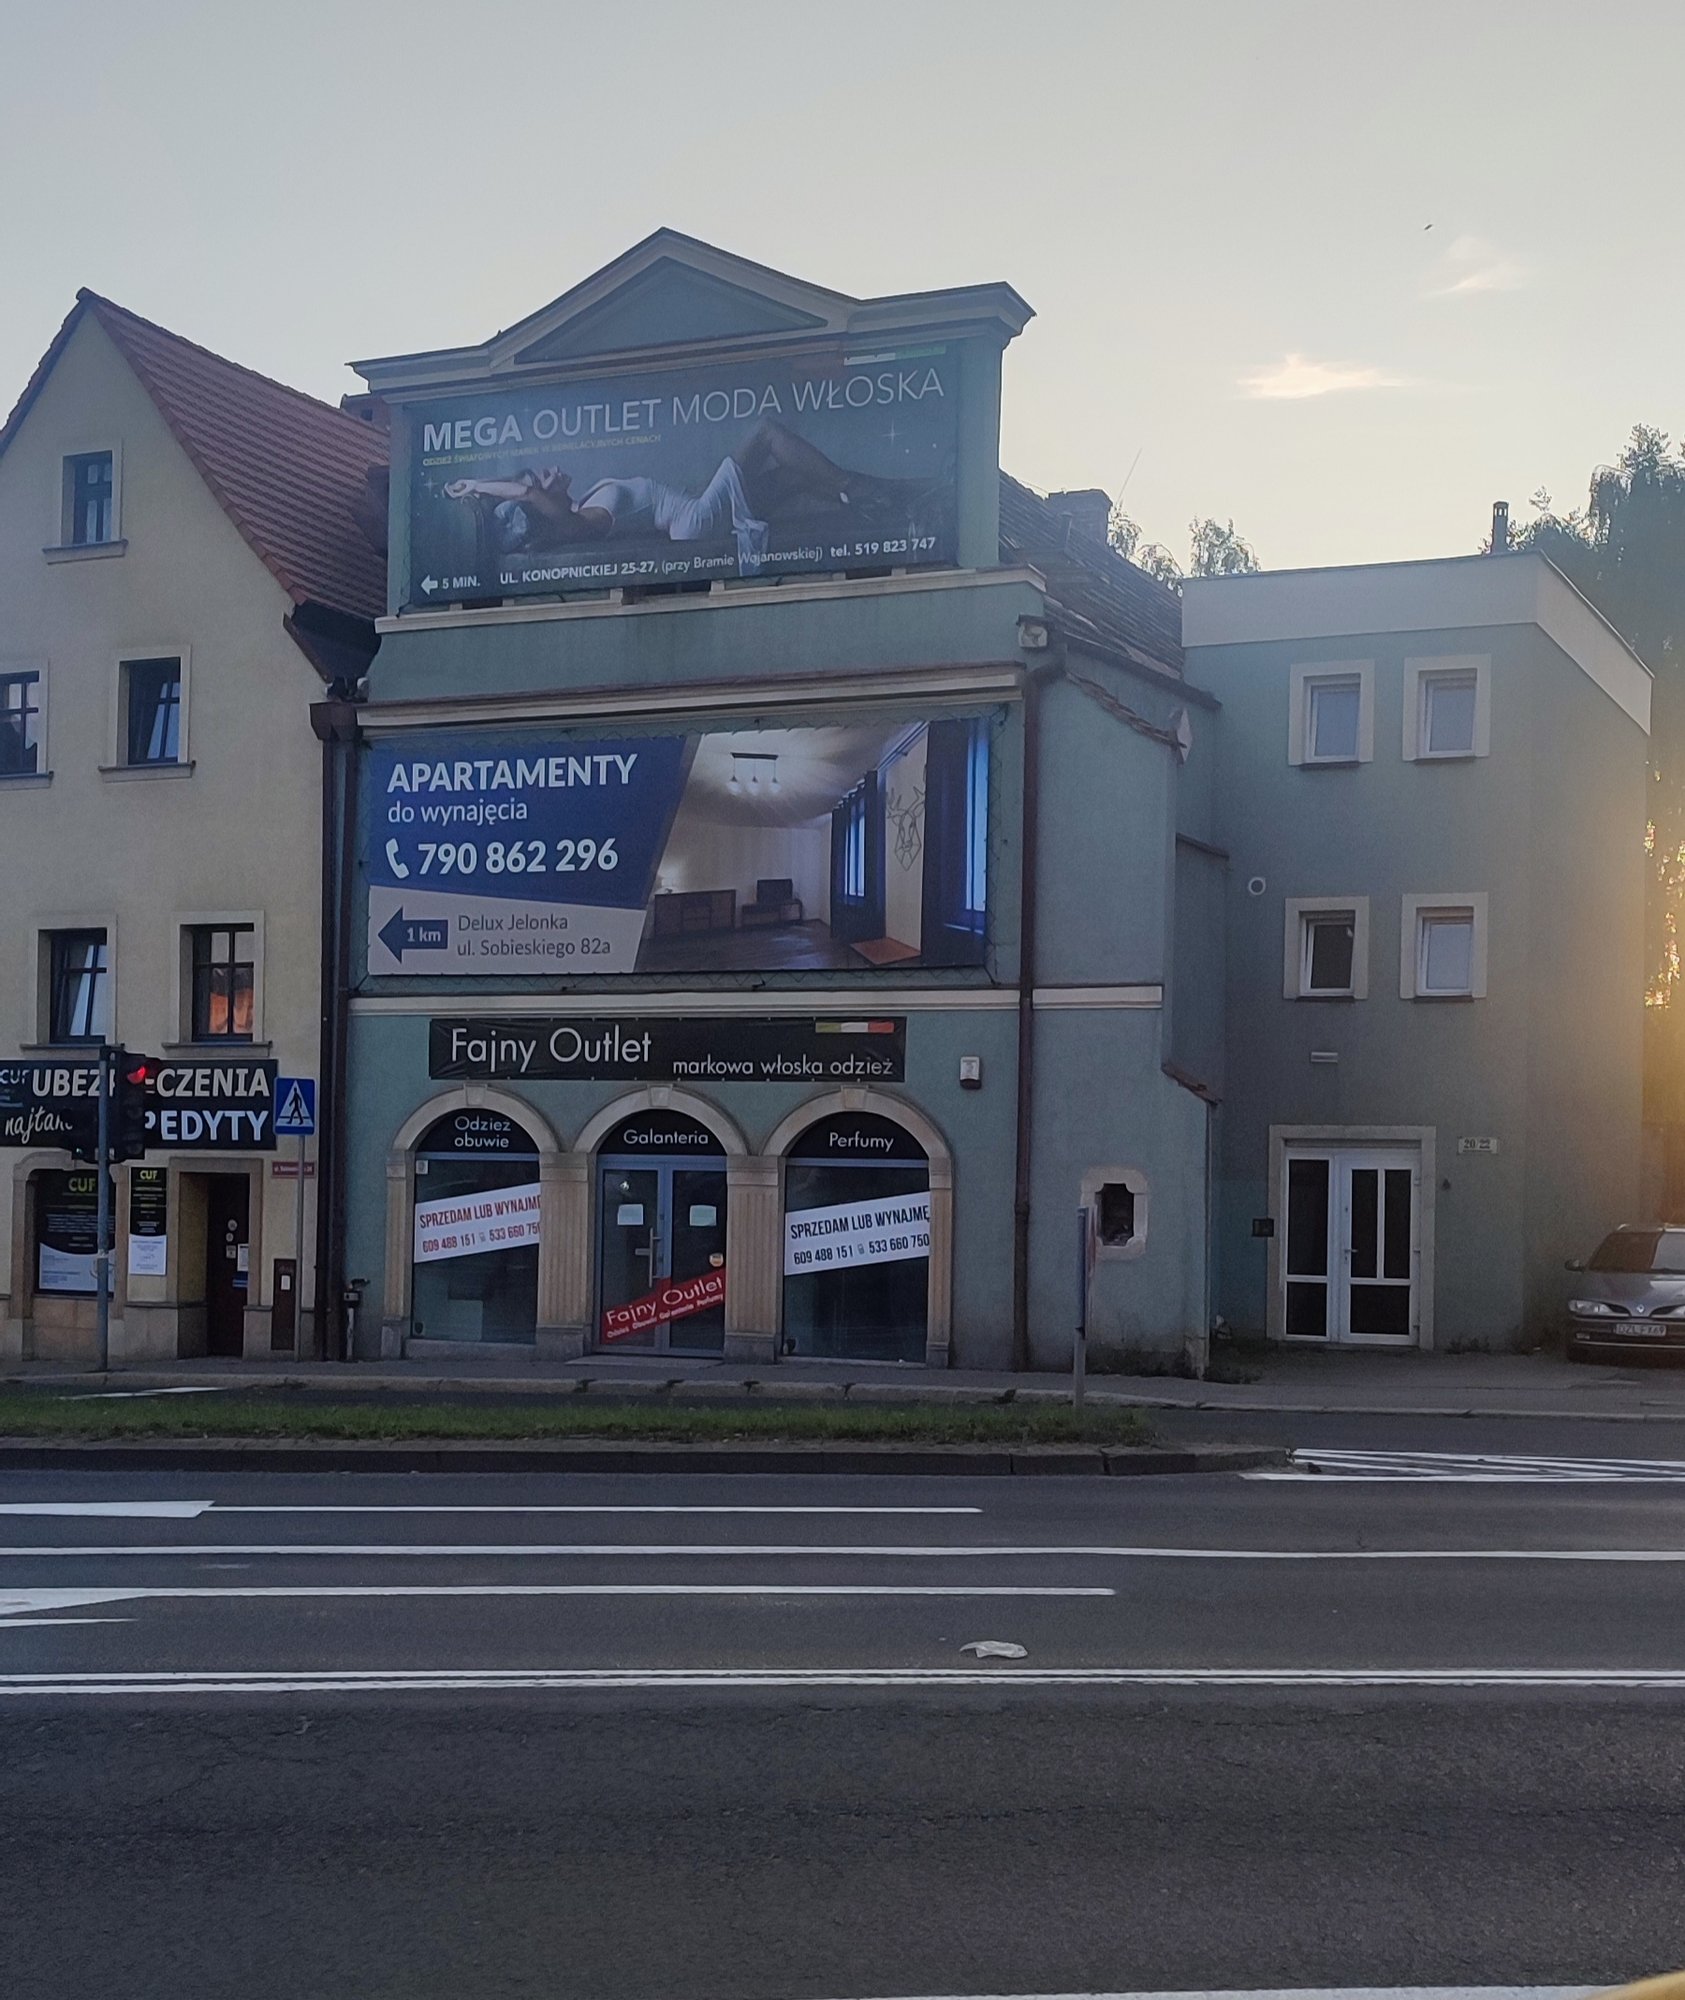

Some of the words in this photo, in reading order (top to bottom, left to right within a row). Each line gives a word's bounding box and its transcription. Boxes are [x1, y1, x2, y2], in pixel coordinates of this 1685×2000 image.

[423, 414, 522, 452] MEGA
[533, 398, 662, 440] OUTLET
[673, 384, 782, 425] MODA
[791, 367, 944, 412] WŁOSKA
[442, 577, 449, 589] 5
[452, 575, 481, 589] MIN.
[500, 572, 519, 585] UL.
[522, 563, 618, 583] KONOPNICKIEJ
[621, 561, 658, 575] 25-27,
[661, 557, 690, 574] (przy
[694, 554, 734, 569] Bramie
[738, 547, 823, 567] Wojanowskiej)
[830, 546, 851, 558] tel.
[855, 542, 879, 555] 519
[883, 540, 907, 553] 823
[911, 537, 935, 550] 747
[387, 753, 638, 793] APARTAMENTY
[387, 800, 414, 823] do
[420, 797, 528, 826] wynajęcia
[417, 842, 477, 875] 790
[485, 840, 546, 874] 862
[555, 837, 619, 871] 296
[407, 927, 415, 942] 1
[419, 926, 441, 942] km
[458, 914, 503, 931] Delux
[508, 913, 568, 931] Jelonka
[457, 941, 475, 956] ul.
[480, 939, 576, 959] Sobieskiego
[581, 938, 610, 954] 82a
[452, 1028, 536, 1073] Fajny
[550, 1024, 651, 1062] Outlet
[673, 1054, 753, 1074] markowa
[760, 1053, 823, 1074] włoska
[830, 1053, 893, 1075] odzież
[33, 1068, 270, 1097] UBEZCZENIA
[455, 1133, 509, 1147] obuwie
[623, 1129, 708, 1144] Galanteria
[829, 1131, 894, 1151] Perfumy
[68, 1178, 96, 1192] CUF
[140, 1170, 158, 1180] CUF
[420, 1207, 472, 1229] SPRZEDAM
[474, 1203, 493, 1219] LUB
[790, 1217, 849, 1239] SPRZEDAM
[852, 1213, 873, 1230] LUB
[875, 1205, 930, 1227] WYNAJMĘ
[422, 1239, 439, 1253] 609
[441, 1235, 458, 1249] 488
[461, 1233, 475, 1247] 151
[489, 1227, 506, 1241] 533
[508, 1225, 525, 1238] 660
[794, 1250, 812, 1265] 609
[815, 1247, 833, 1261] 488
[837, 1245, 853, 1259] 151
[869, 1239, 887, 1254] 533
[890, 1236, 908, 1251] 660
[911, 1233, 930, 1248] 750
[606, 1301, 656, 1325] Fajny
[663, 1276, 722, 1305] Outlet
